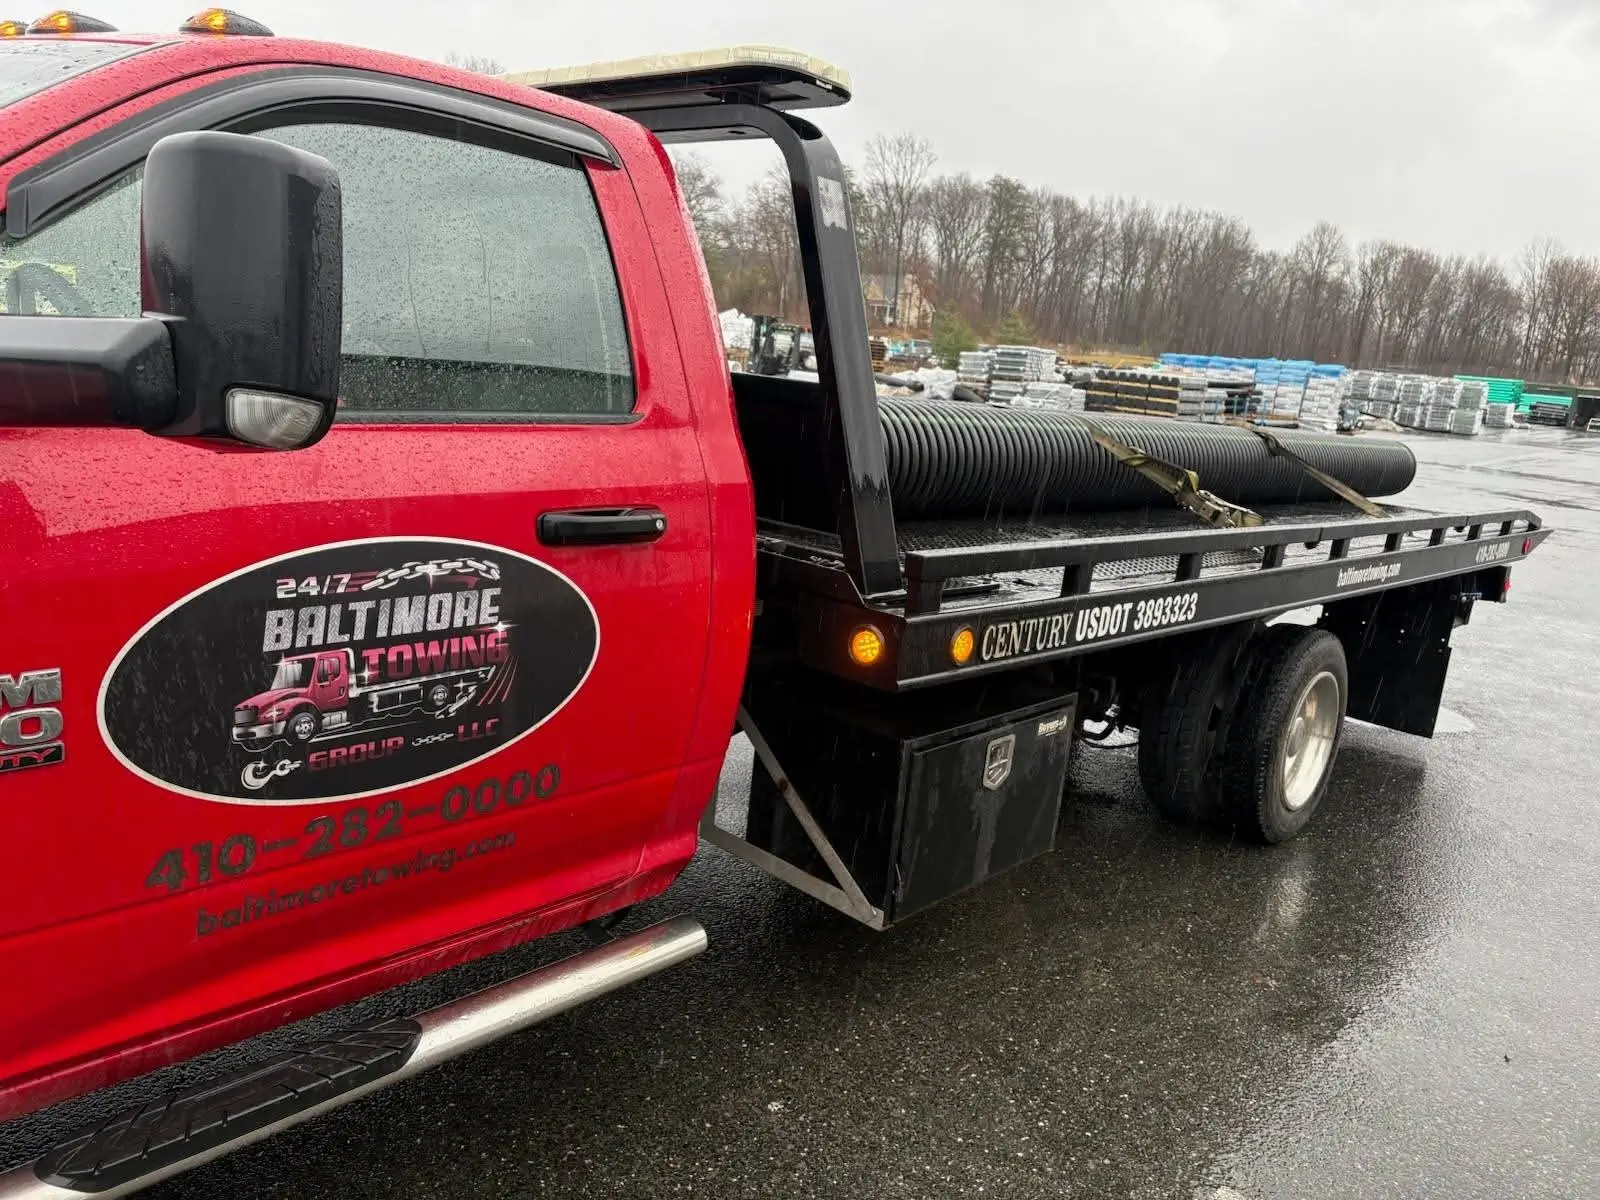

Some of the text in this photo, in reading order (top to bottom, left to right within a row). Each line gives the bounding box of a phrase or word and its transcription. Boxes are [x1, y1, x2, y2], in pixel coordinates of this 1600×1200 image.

[276, 574, 351, 599] 24/7
[263, 587, 502, 651] BALTIMORE
[981, 592, 1199, 661] CENTURY USDOT 3893323
[361, 630, 508, 682] TOWING
[308, 717, 499, 772] GROUP LLC
[144, 763, 561, 892] 410-282-0000
[195, 831, 517, 938] baltimoretowing.com
